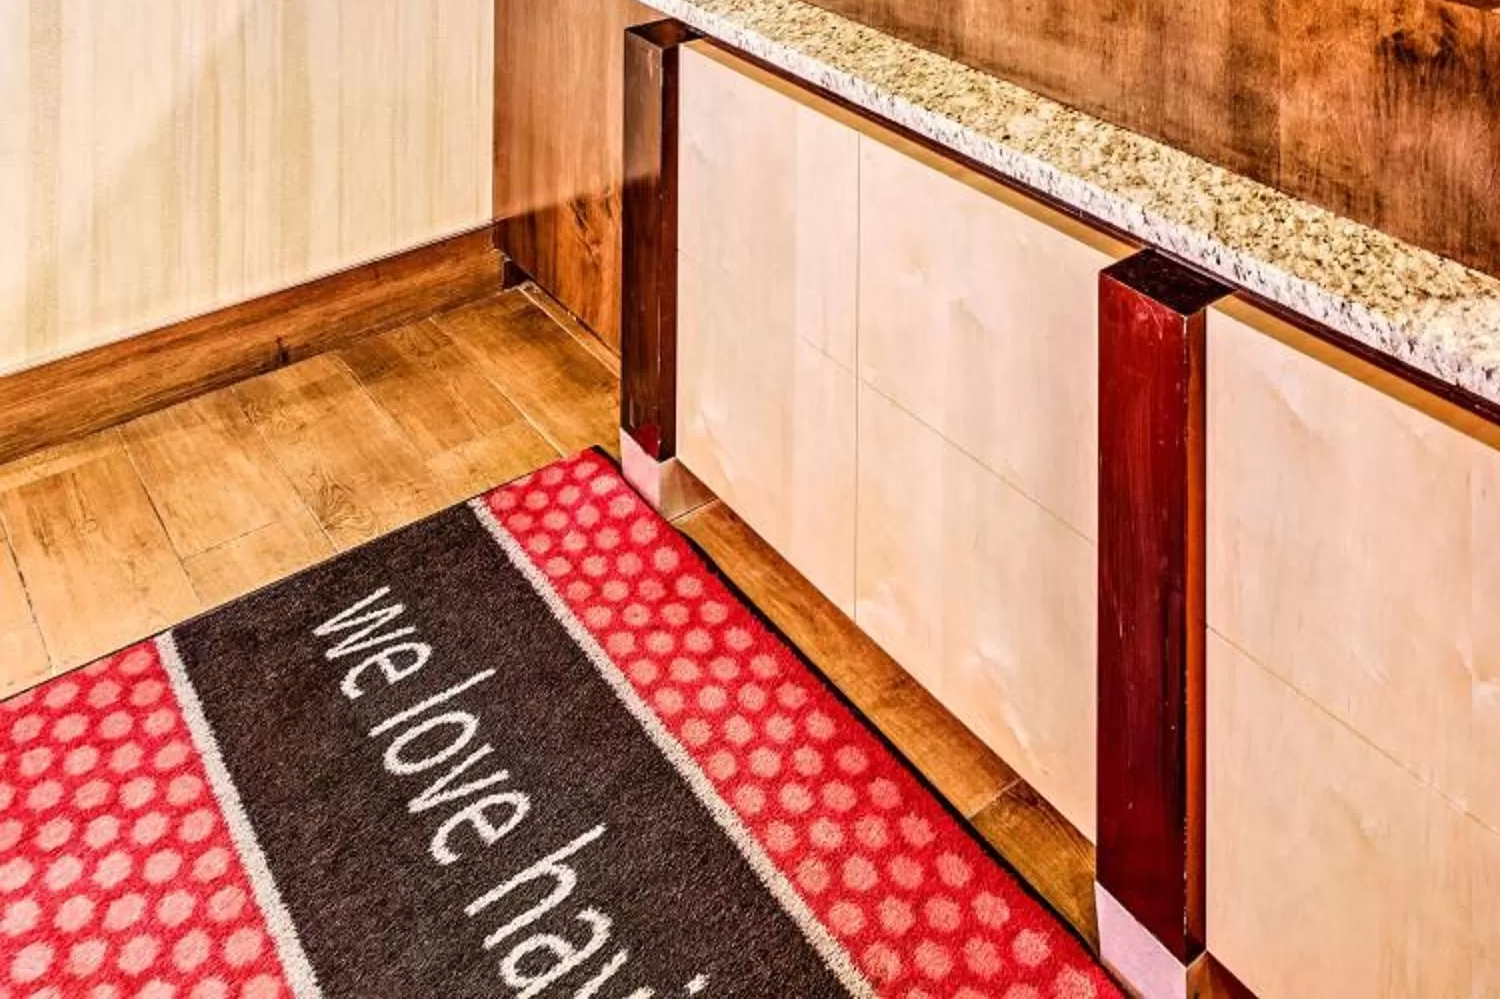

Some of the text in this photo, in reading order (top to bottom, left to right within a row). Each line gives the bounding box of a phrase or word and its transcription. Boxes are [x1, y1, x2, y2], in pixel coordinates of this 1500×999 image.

[313, 585, 710, 999] we love ha
